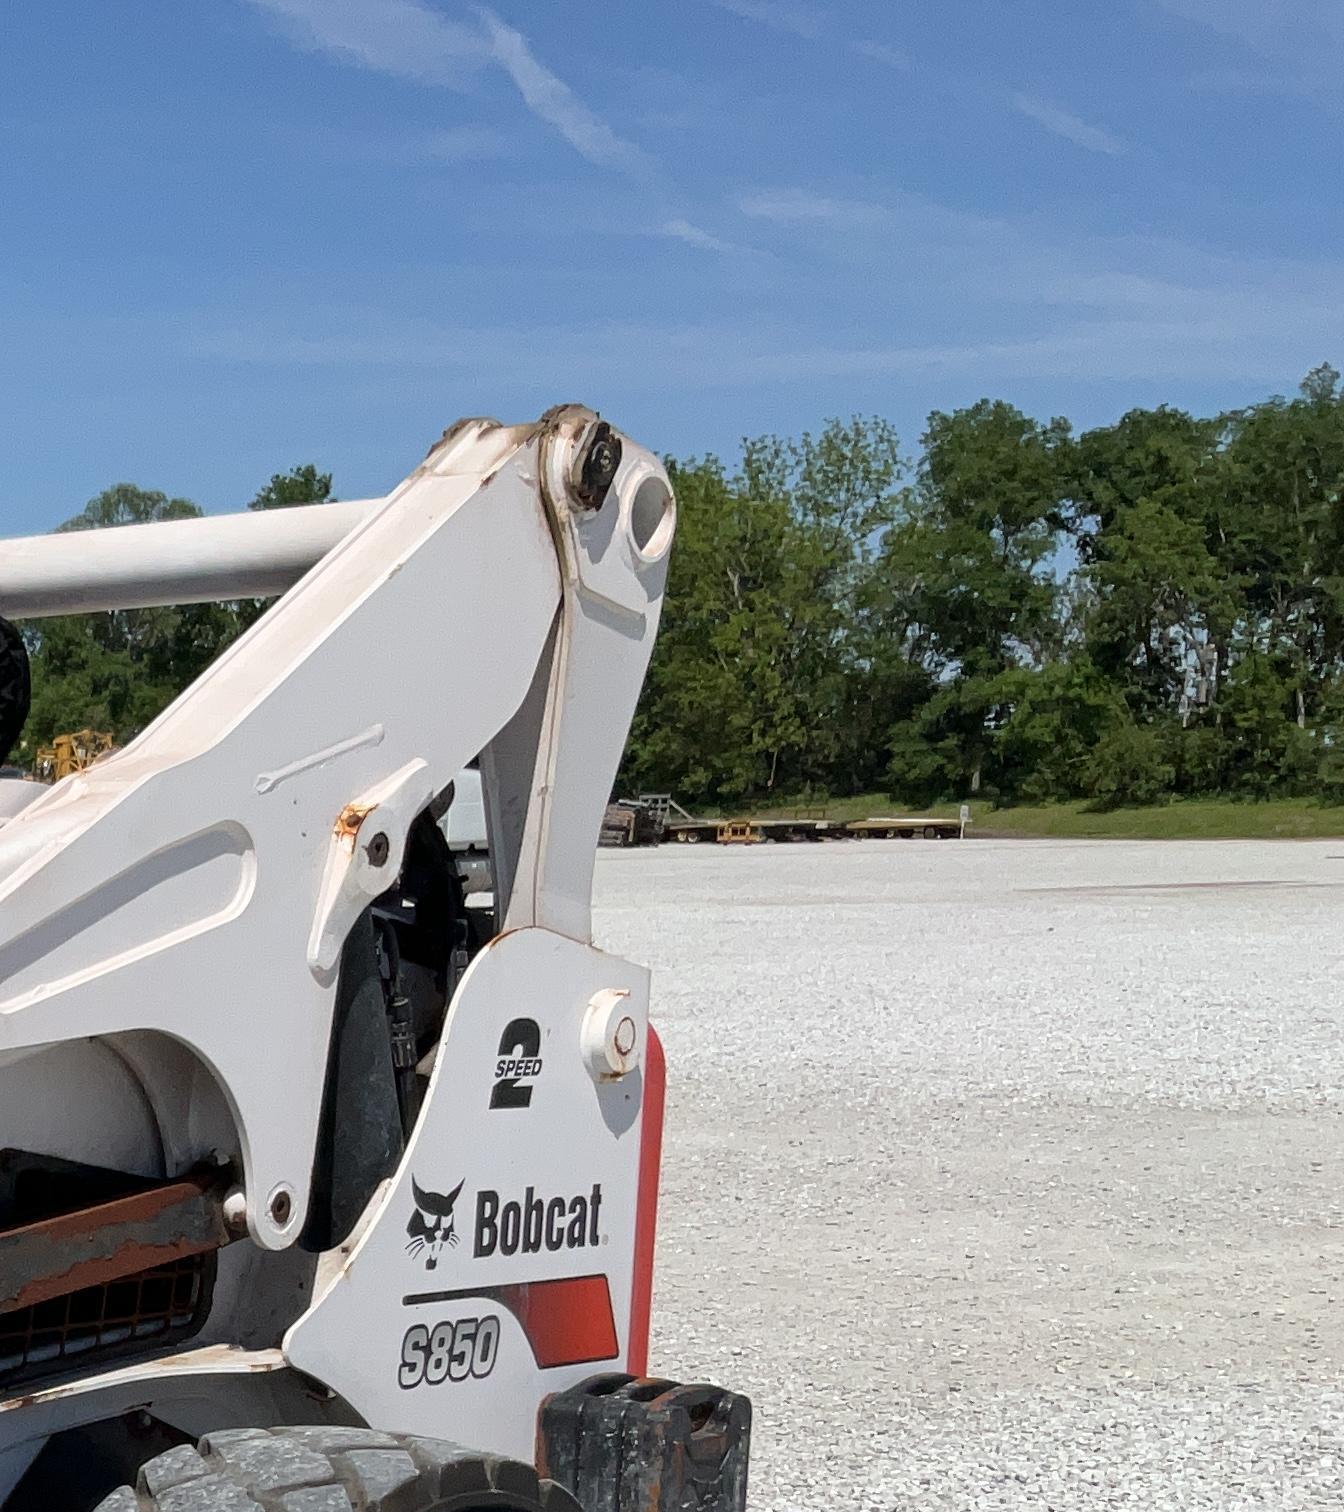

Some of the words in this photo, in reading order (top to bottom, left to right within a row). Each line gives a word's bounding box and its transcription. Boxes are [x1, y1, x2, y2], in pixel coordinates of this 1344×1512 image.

[489, 1018, 540, 1109] 2
[495, 1059, 543, 1078] SPEED
[473, 1184, 601, 1258] Bobcat
[398, 1315, 500, 1390] S850
